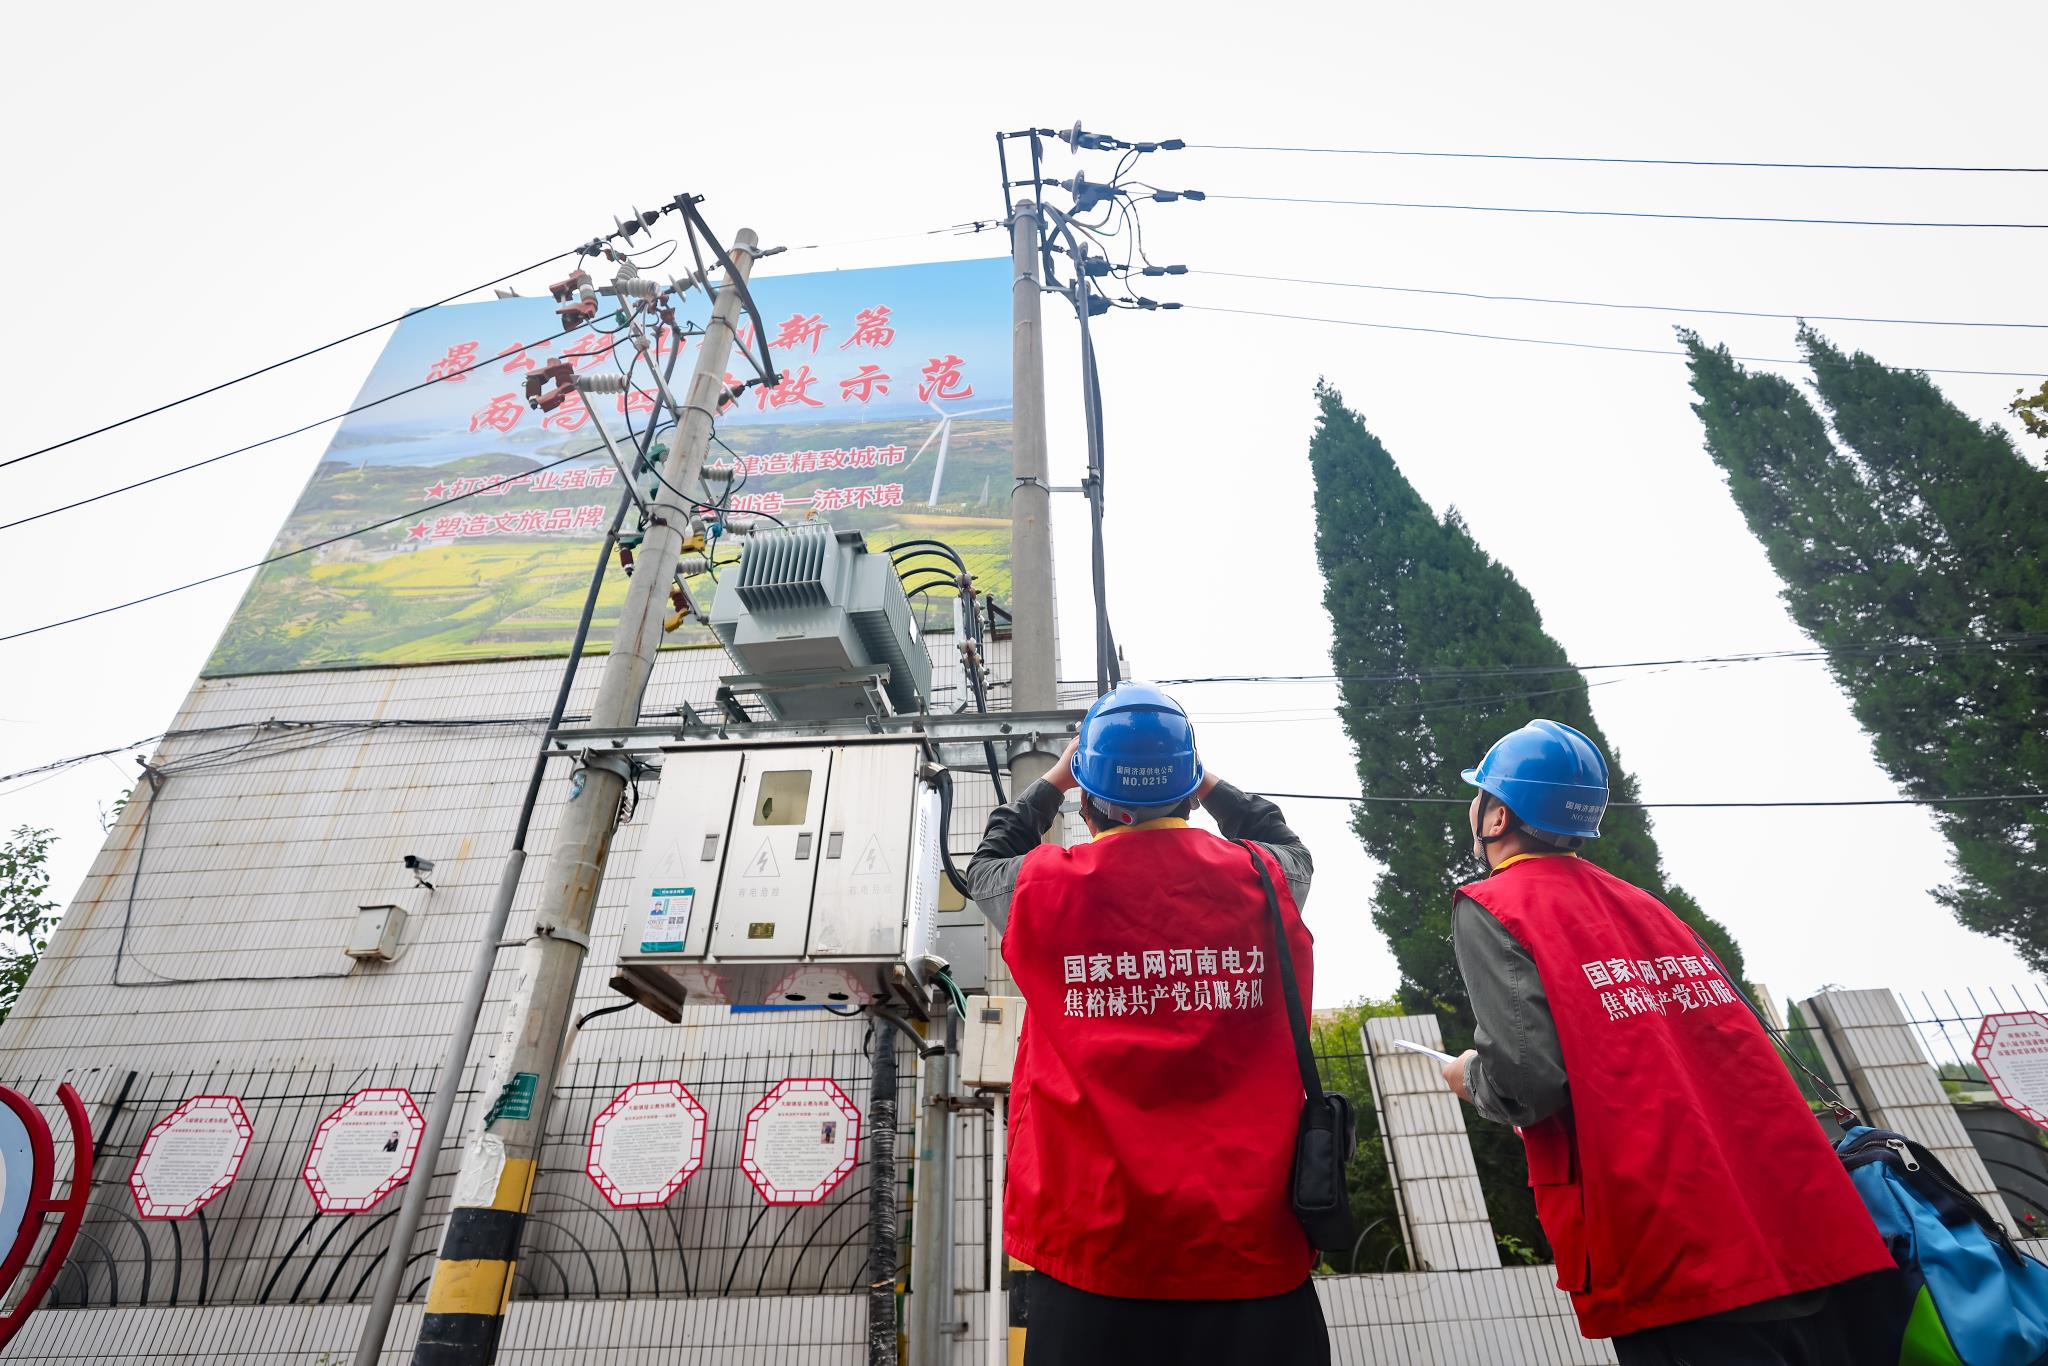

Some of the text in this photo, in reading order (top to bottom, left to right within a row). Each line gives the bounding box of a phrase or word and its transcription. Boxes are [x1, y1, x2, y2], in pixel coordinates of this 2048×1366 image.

[733, 445, 907, 477] 建造精致城市
[448, 466, 618, 499] 打造产业强市
[725, 482, 904, 520] 创造一流环境
[430, 504, 606, 540] 塑造文旅品牌
[1122, 775, 1168, 786] NO.0215
[1063, 945, 1265, 984] 国家电网河南电力
[1063, 978, 1264, 1018] 焦裕禄共产党员服务队
